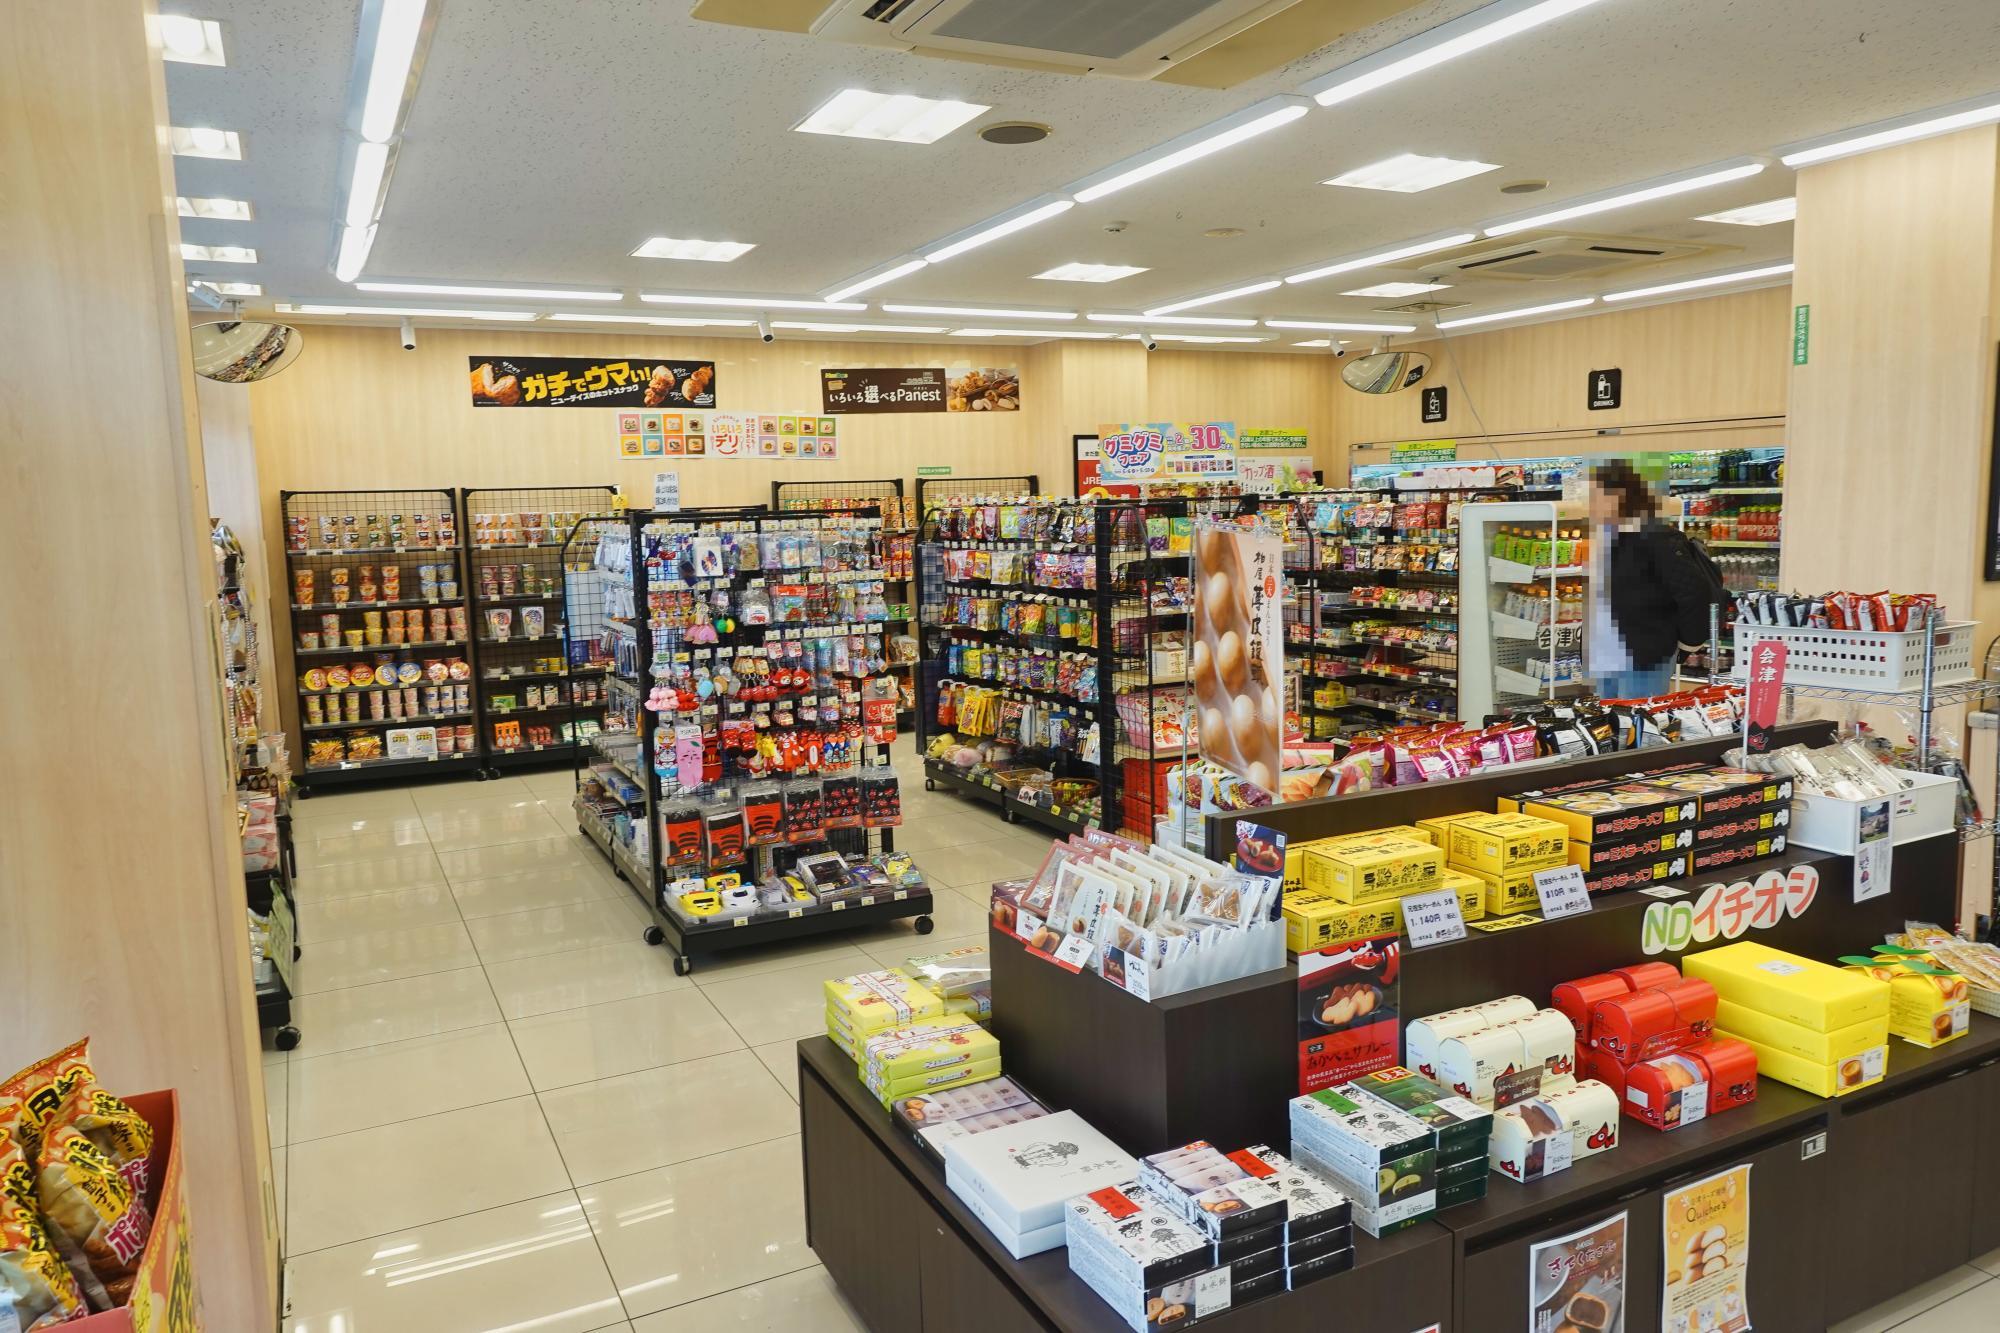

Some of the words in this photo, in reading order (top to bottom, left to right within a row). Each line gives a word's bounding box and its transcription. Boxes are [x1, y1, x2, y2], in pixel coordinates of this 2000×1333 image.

[521, 362, 651, 402] ガチでウマい!
[551, 385, 639, 405] ニューデイズのホットスナック
[716, 434, 739, 448] デリ
[1104, 431, 1163, 457] グミグミ
[1118, 451, 1150, 467] フェア
[1759, 647, 1778, 684] 会津
[1545, 888, 1565, 899] 810円
